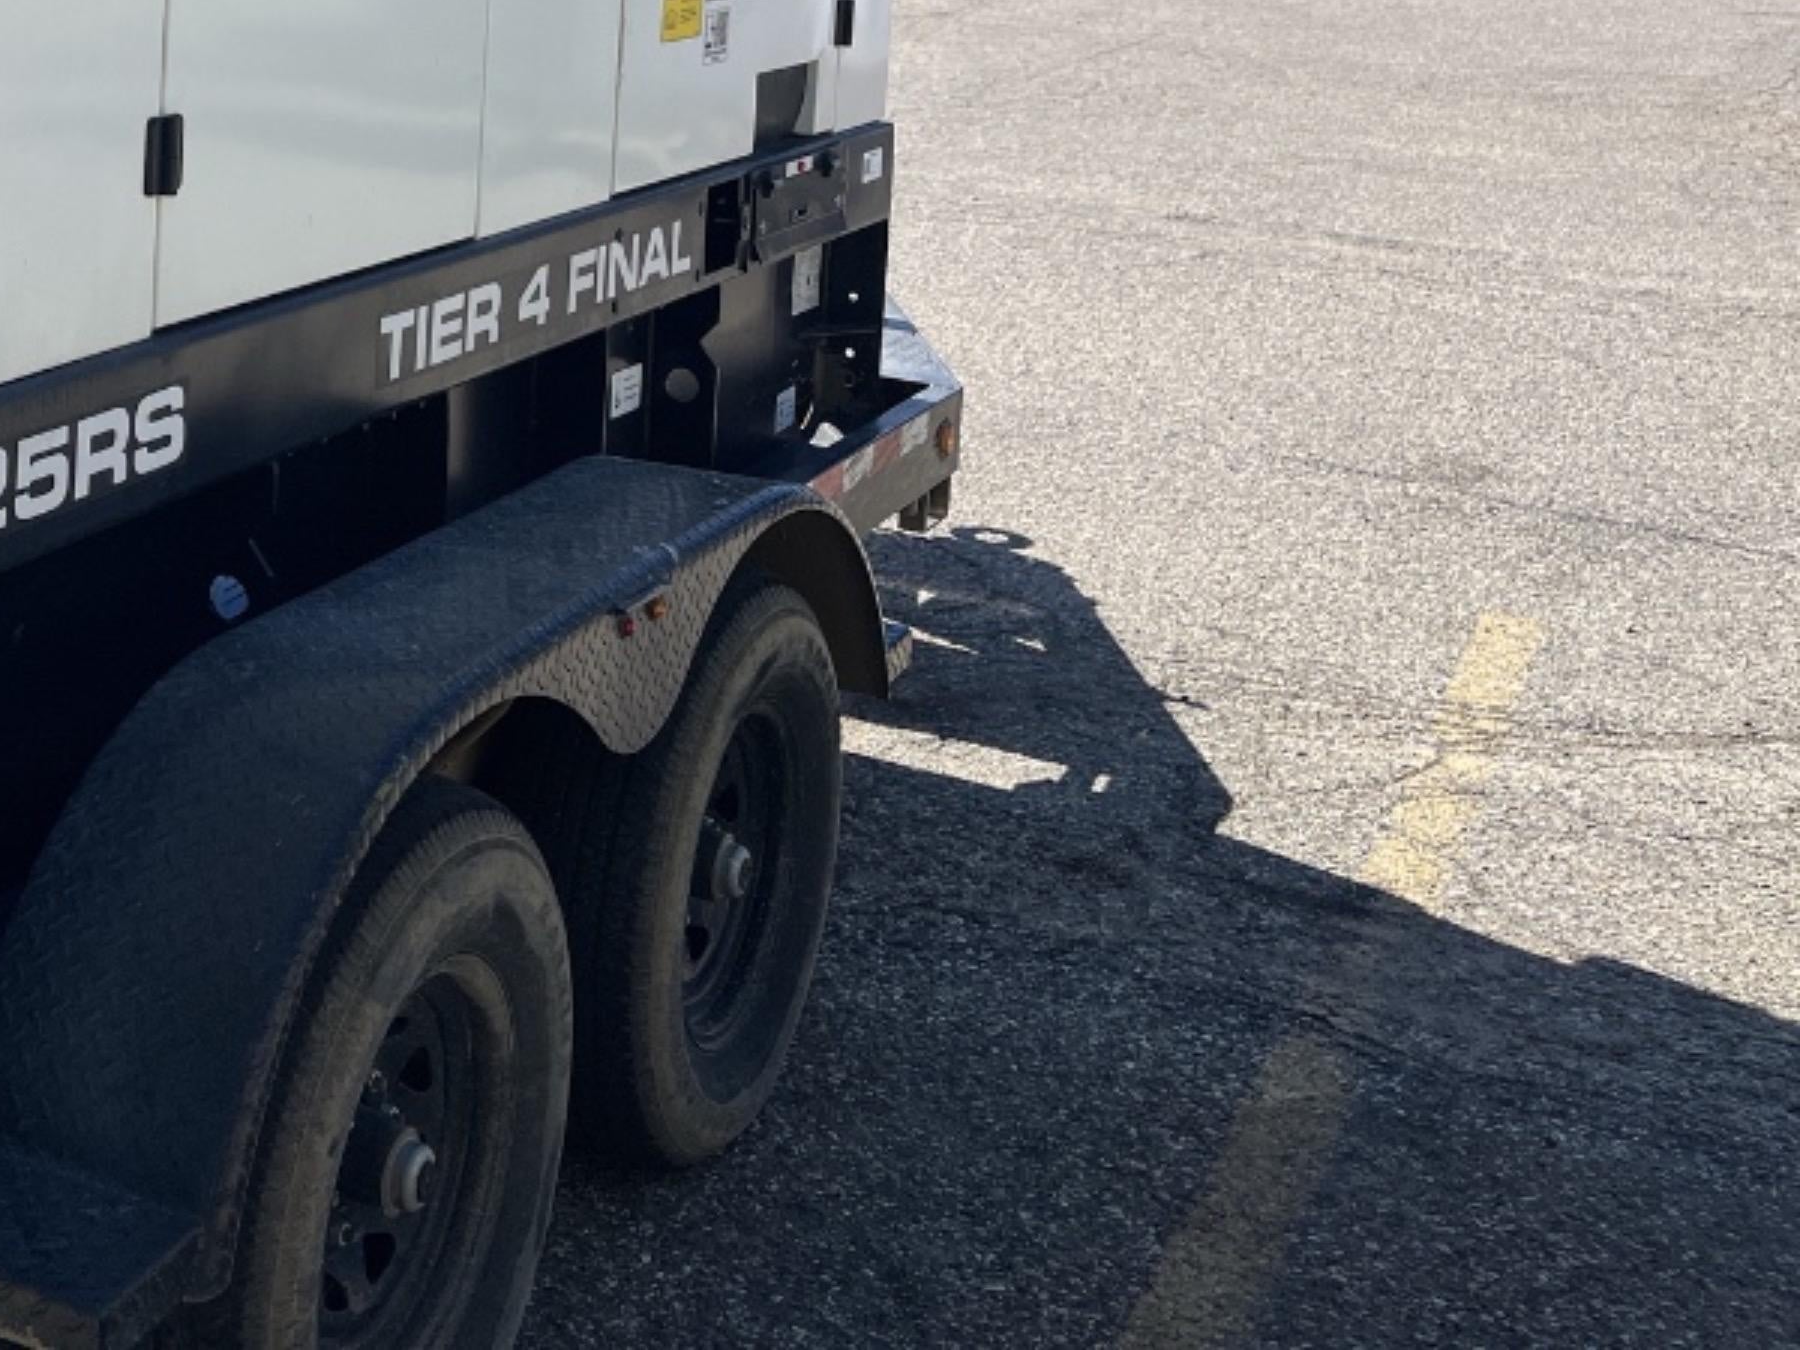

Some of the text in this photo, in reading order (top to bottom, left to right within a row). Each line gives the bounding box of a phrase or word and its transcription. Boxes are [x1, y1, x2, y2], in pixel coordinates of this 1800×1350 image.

[379, 280, 502, 381] TIER
[517, 264, 550, 326] 4
[566, 218, 692, 315] FINAL
